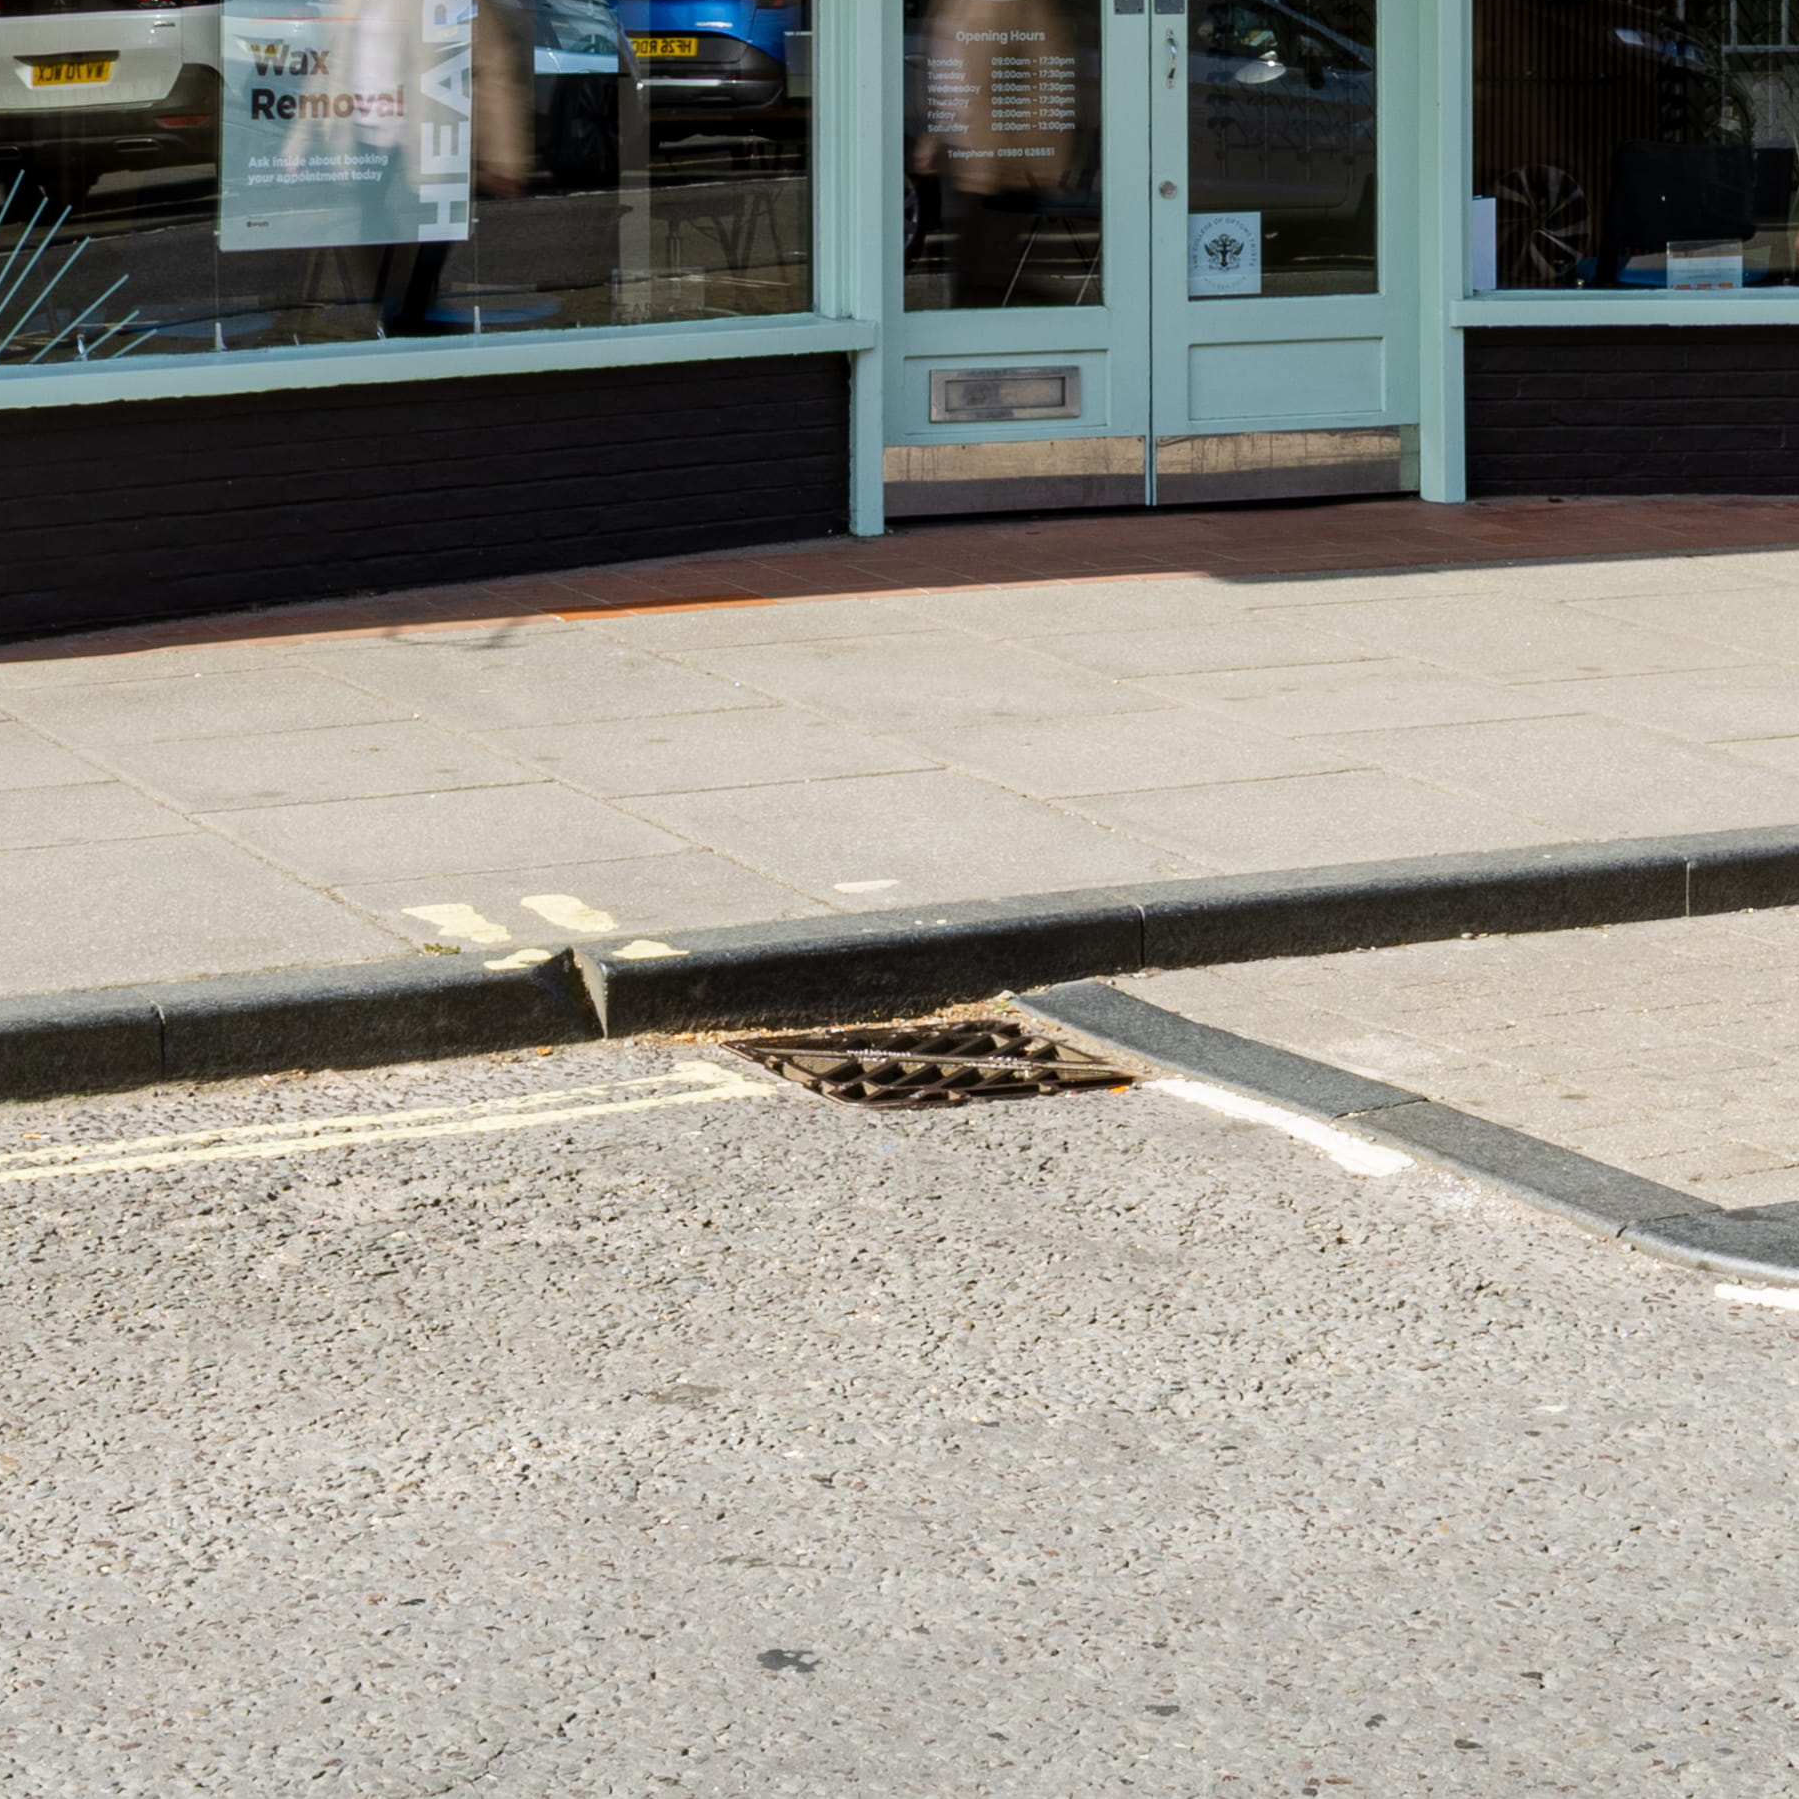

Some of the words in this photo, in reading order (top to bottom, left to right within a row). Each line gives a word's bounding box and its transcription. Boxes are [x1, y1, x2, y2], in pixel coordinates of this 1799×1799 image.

[955, 29, 1009, 46] Opening
[1009, 29, 1046, 42] Hours
[250, 44, 330, 77] Wax
[927, 57, 964, 68] Monday
[990, 57, 1031, 65] 09:00am
[1038, 56, 1076, 67] 17:30pm
[927, 70, 966, 82] Tuesday
[990, 70, 1031, 79] 09:00am
[1038, 69, 1076, 80] 17:30pm
[927, 83, 981, 95] Wednesday
[990, 83, 1031, 93] 09:00am
[1038, 82, 1076, 94] 17:30pm
[251, 84, 406, 120] Removal
[927, 97, 970, 108] Thursday
[990, 96, 1031, 105] 09:00am
[1038, 95, 1076, 106] 17:30pm
[927, 110, 956, 121] Friday
[990, 109, 1031, 118] 09:00am
[1038, 109, 1076, 119] 17:30pm
[927, 123, 970, 134] Saturday
[990, 123, 1031, 131] 09:00am
[1038, 121, 1076, 133] 13:00pm
[248, 155, 271, 168] Ask
[272, 154, 306, 168] inside
[308, 153, 342, 166] about
[344, 152, 389, 168] booking
[947, 148, 994, 161] Telephone
[248, 171, 276, 185] your
[277, 169, 349, 185] appointment
[351, 167, 383, 182] today
